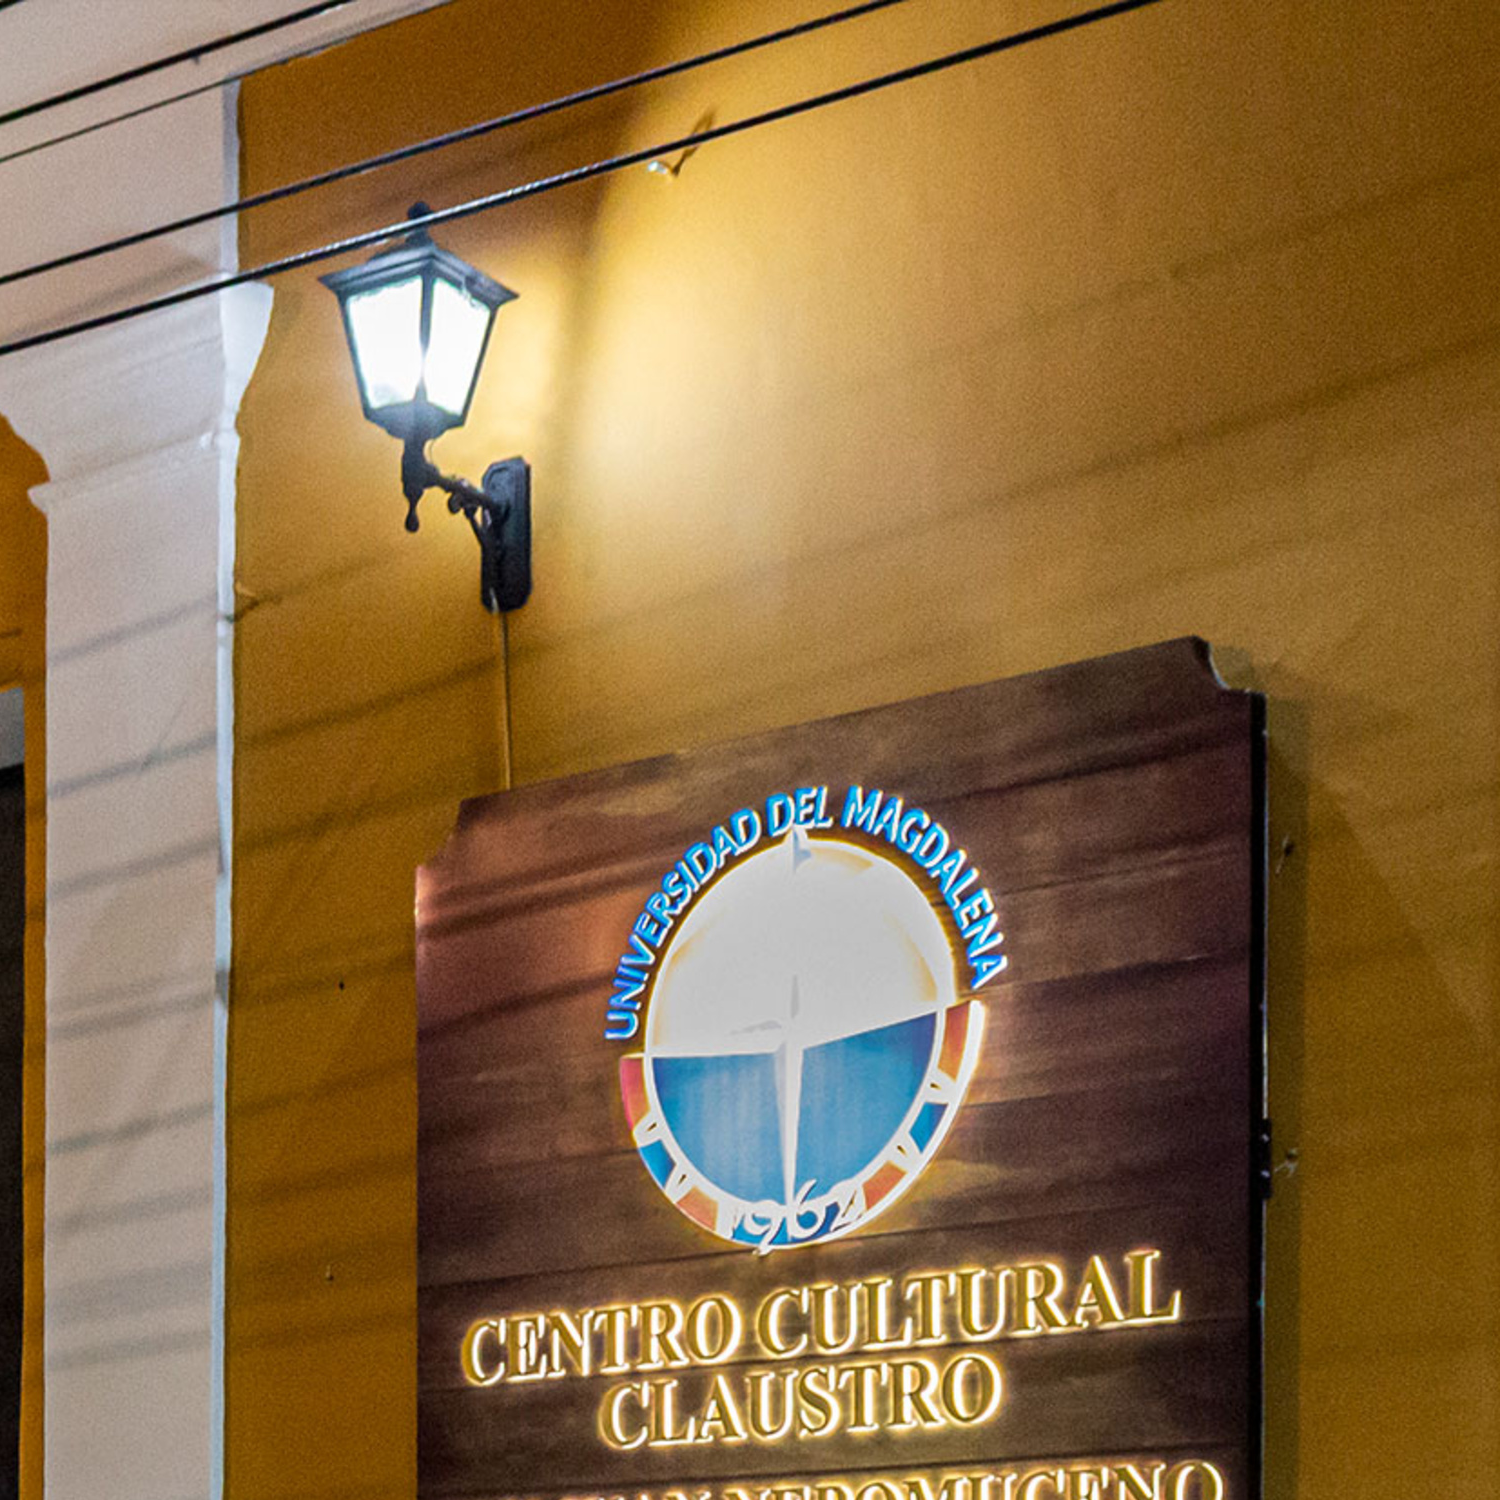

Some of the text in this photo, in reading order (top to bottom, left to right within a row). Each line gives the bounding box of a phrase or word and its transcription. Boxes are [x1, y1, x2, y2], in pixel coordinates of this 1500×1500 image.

[605, 784, 1008, 1040] UNIVERSIDAD DEL MAGDALENA
[461, 1250, 1181, 1386] CENTRO CULTURAL
[600, 1353, 1001, 1449] CLAUSTRO
